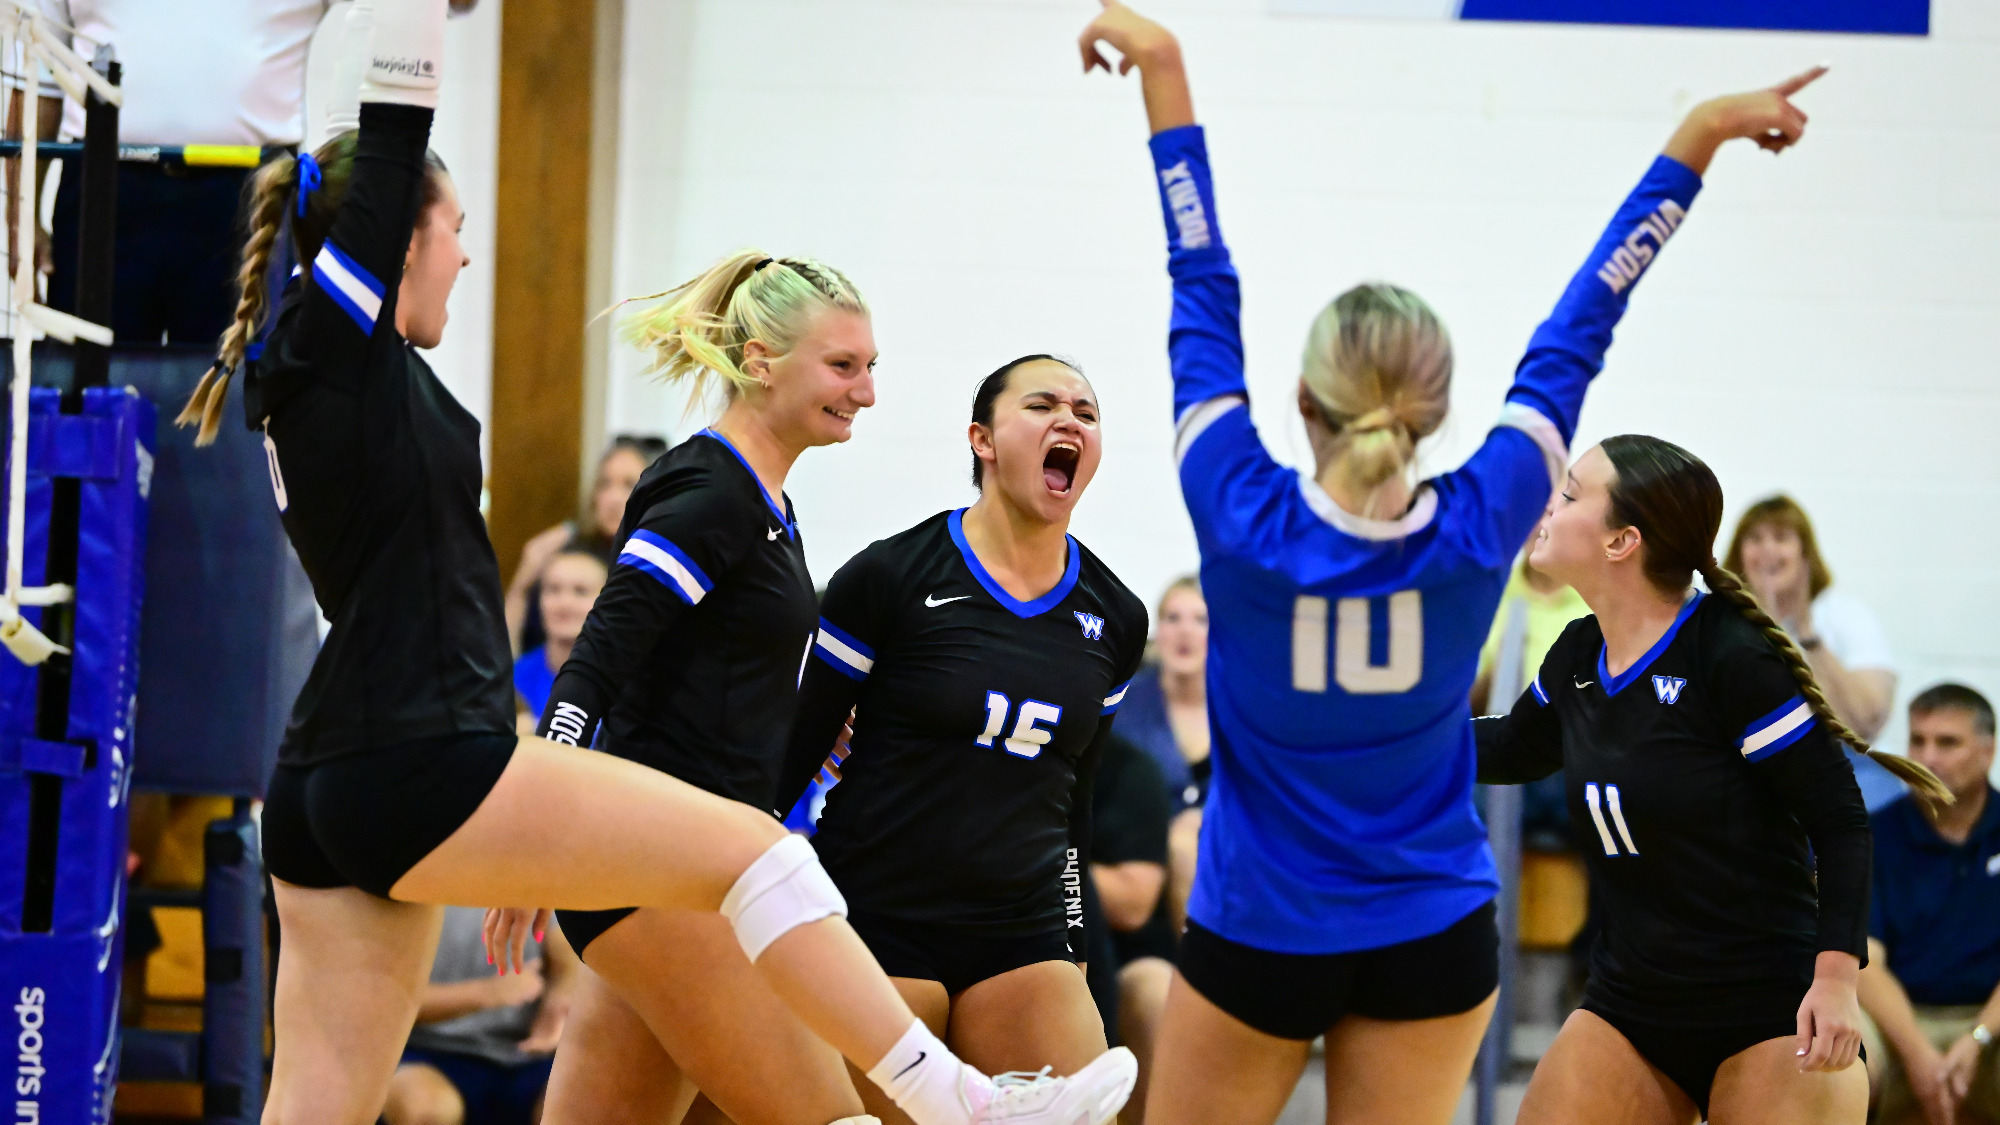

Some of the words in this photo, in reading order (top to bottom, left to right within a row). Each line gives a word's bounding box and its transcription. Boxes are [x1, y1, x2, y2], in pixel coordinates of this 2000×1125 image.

[1073, 610, 1105, 641] W
[1292, 588, 1423, 694] 10
[1652, 674, 1687, 705] W
[1585, 781, 1641, 858] 11
[14, 986, 46, 1096] sports
